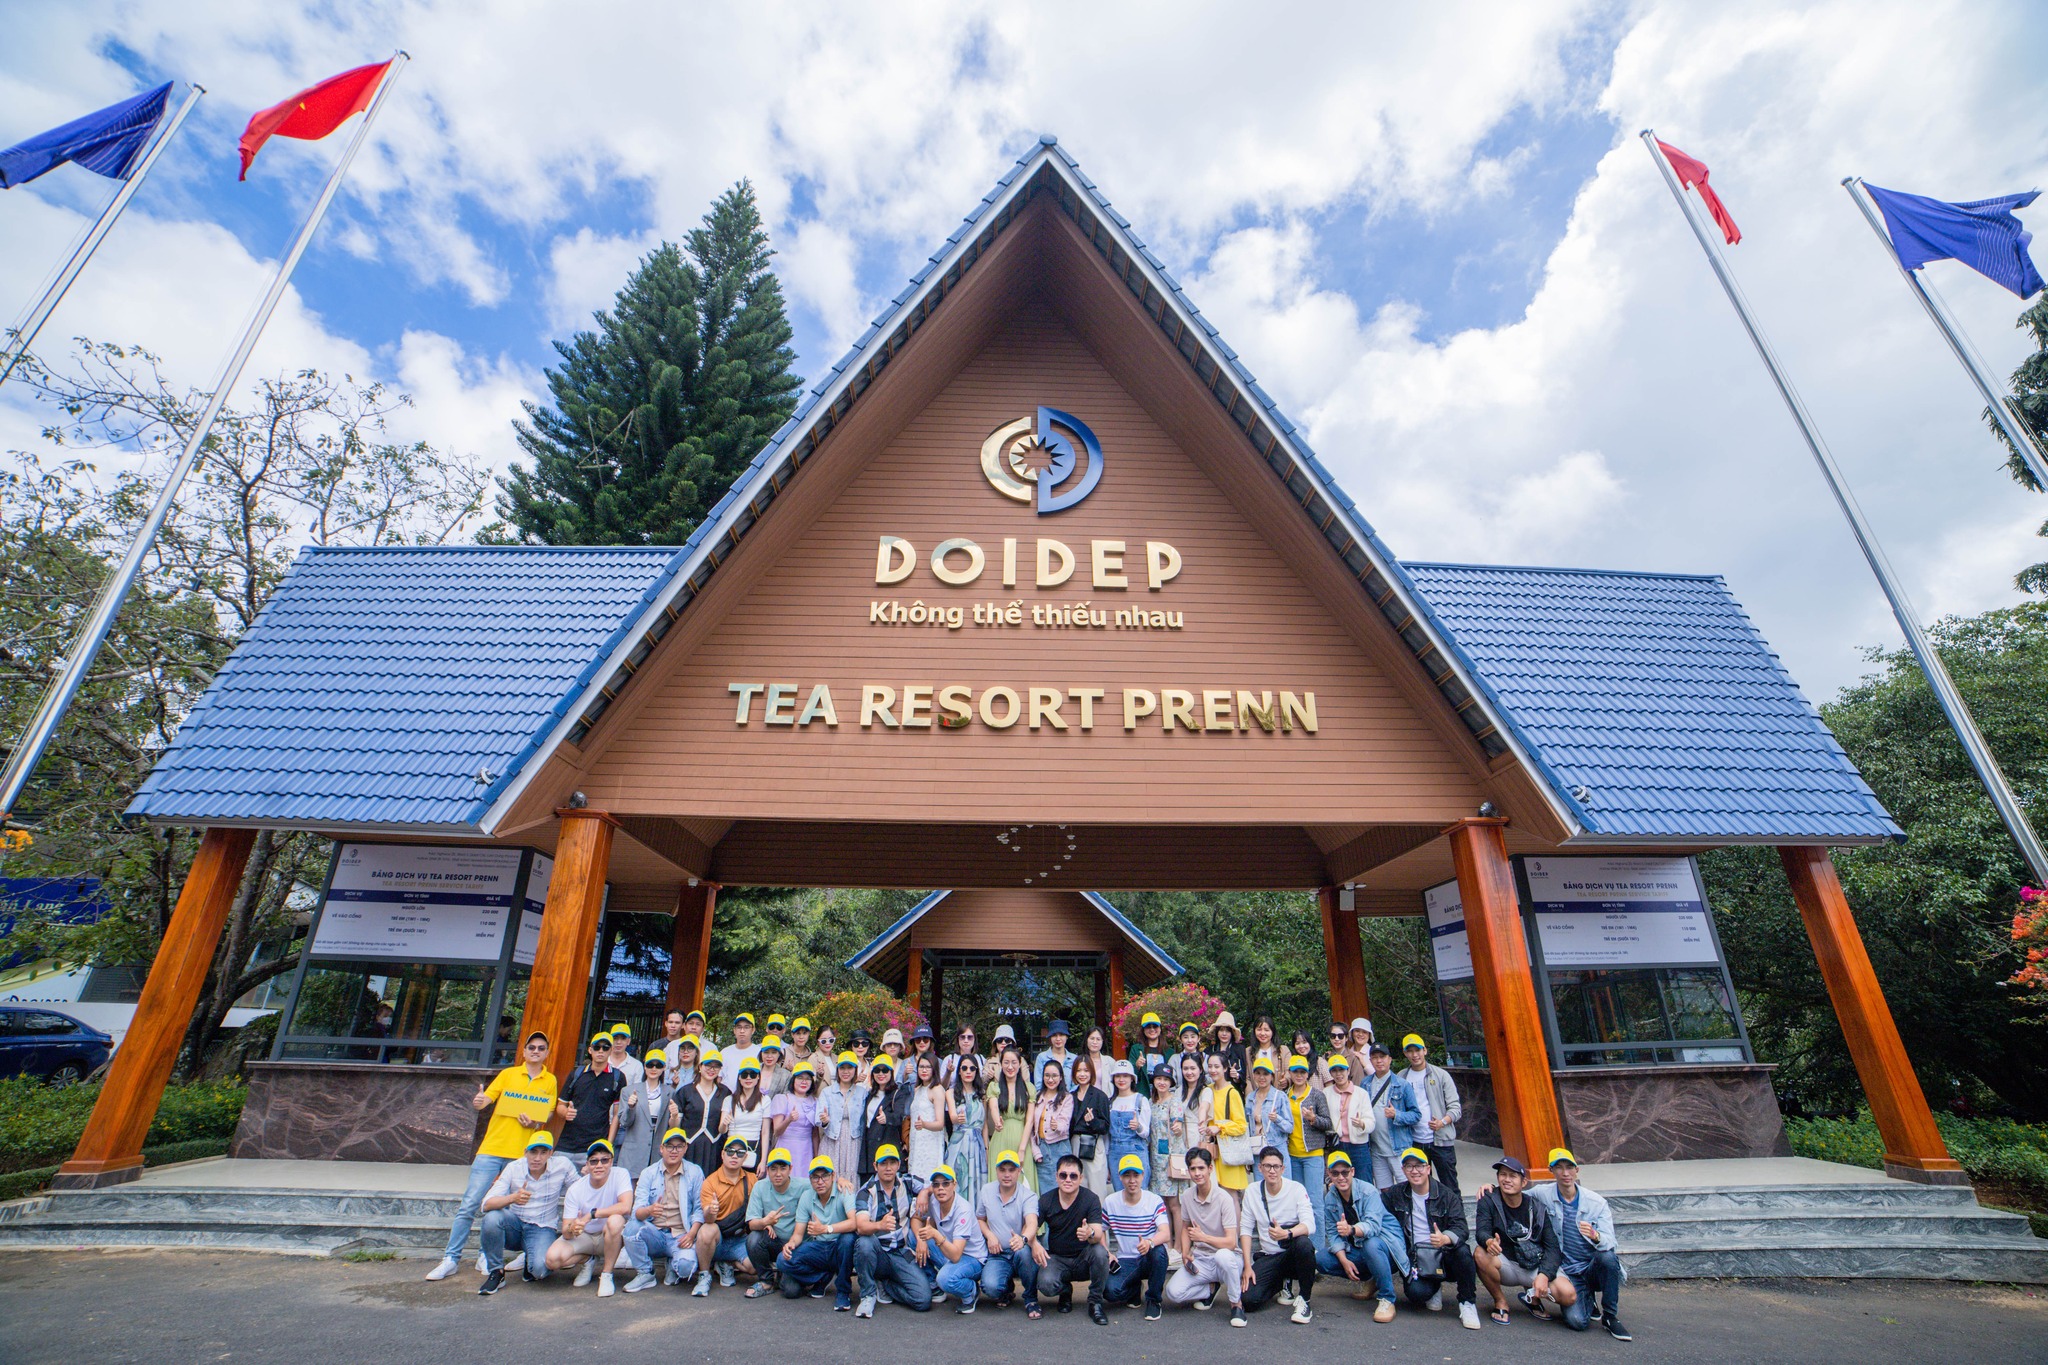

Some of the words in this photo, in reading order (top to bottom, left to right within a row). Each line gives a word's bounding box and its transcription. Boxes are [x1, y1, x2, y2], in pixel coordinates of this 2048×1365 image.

[875, 536, 1182, 590] DOIDEP
[869, 600, 964, 629] Không
[973, 599, 1023, 625] thể
[1032, 601, 1106, 626] thiếu
[1115, 605, 1184, 628] nhau
[728, 683, 838, 726] TEA
[860, 685, 1104, 730] RESORT
[1123, 688, 1318, 732] PRENN
[371, 869, 393, 878] BẢNG
[395, 872, 415, 880] DỊCH
[417, 872, 428, 881] VỤ
[1563, 881, 1584, 889] BẢNG
[1605, 883, 1614, 891] VỤ
[529, 1095, 549, 1103] BANK
